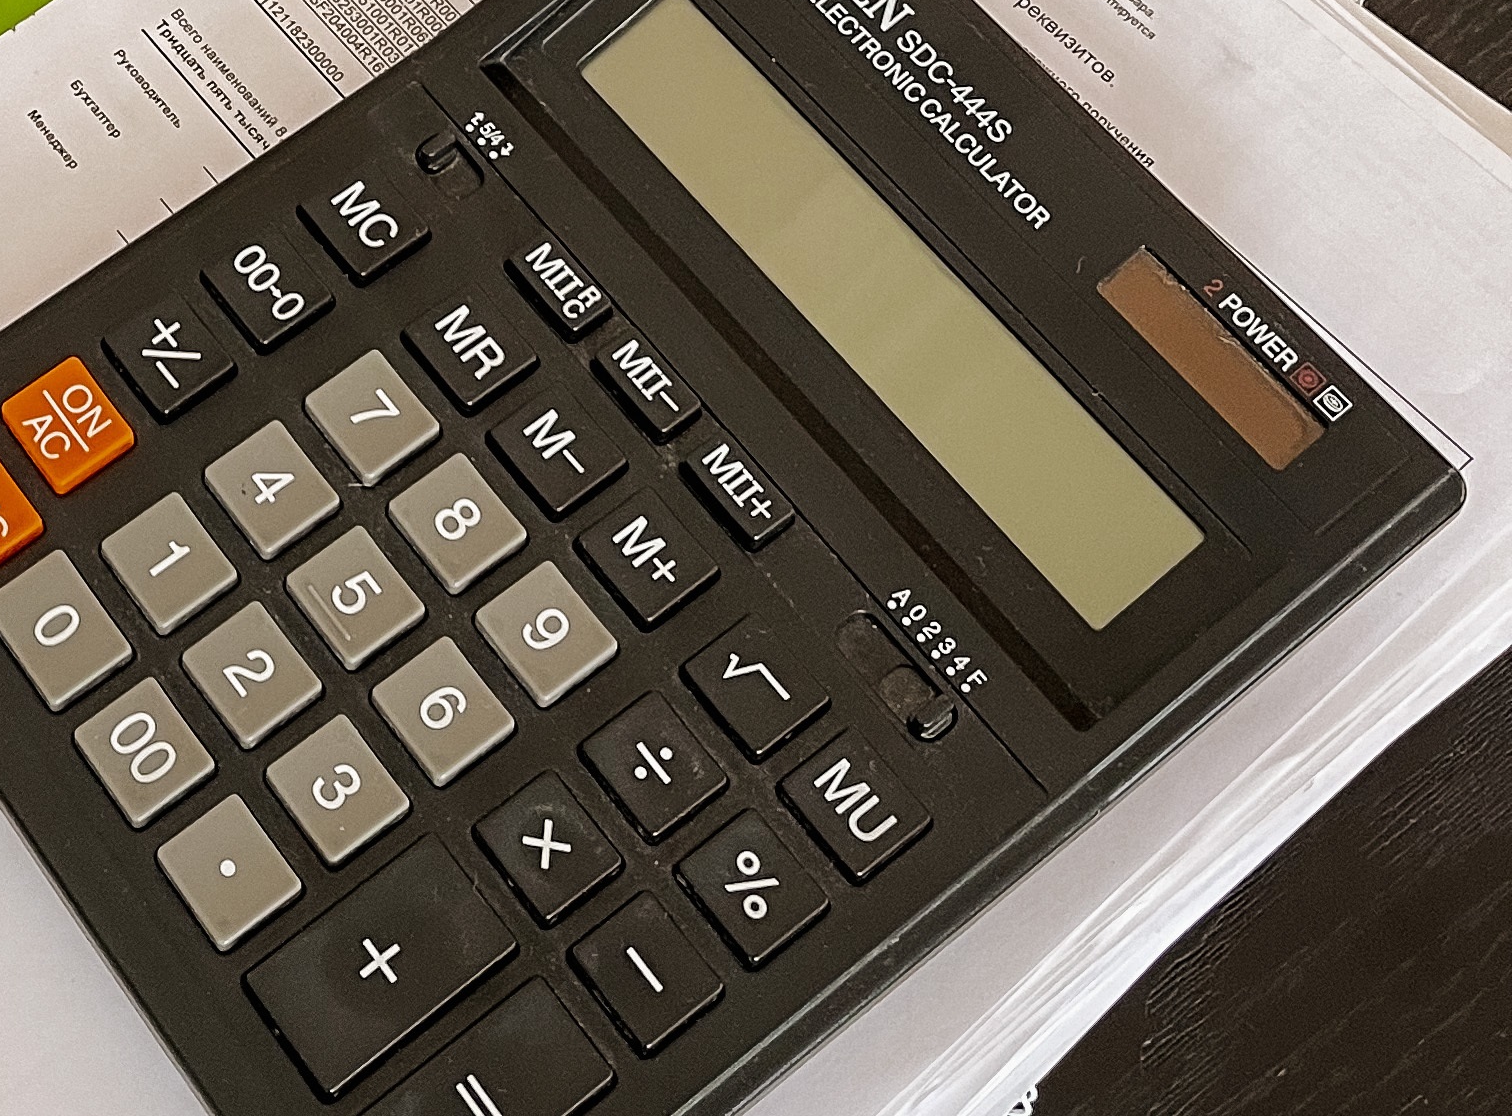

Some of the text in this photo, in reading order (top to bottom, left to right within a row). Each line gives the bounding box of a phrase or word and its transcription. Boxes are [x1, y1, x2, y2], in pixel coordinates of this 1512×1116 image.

[114, 49, 180, 128] Руководитель
[156, 19, 270, 151] Тридцать пять тысяч
[171, 8, 203, 44] Всего
[200, 44, 278, 128] наименований
[897, 30, 1012, 142] SDC-444S
[70, 79, 121, 138] Бухгалтер
[27, 110, 78, 169] Менеджер
[920, 99, 1050, 229] CALCULATOR
[331, 181, 398, 247] MC
[435, 305, 504, 380] MR
[1203, 279, 1298, 372] 2 POWER
[63, 384, 112, 438] ON
[350, 389, 400, 423] 7
[22, 415, 70, 459] AC
[252, 473, 294, 504] 4
[435, 499, 480, 540] 8
[612, 516, 676, 582] M+
[150, 541, 190, 576] 1
[334, 571, 382, 614] 5
[35, 605, 79, 645] 0
[523, 609, 569, 649] 9
[223, 650, 274, 697] 2
[420, 687, 466, 729] 6
[111, 713, 176, 782] 00
[313, 765, 360, 809] 3
[814, 758, 897, 841] MU
[724, 851, 780, 920] %
